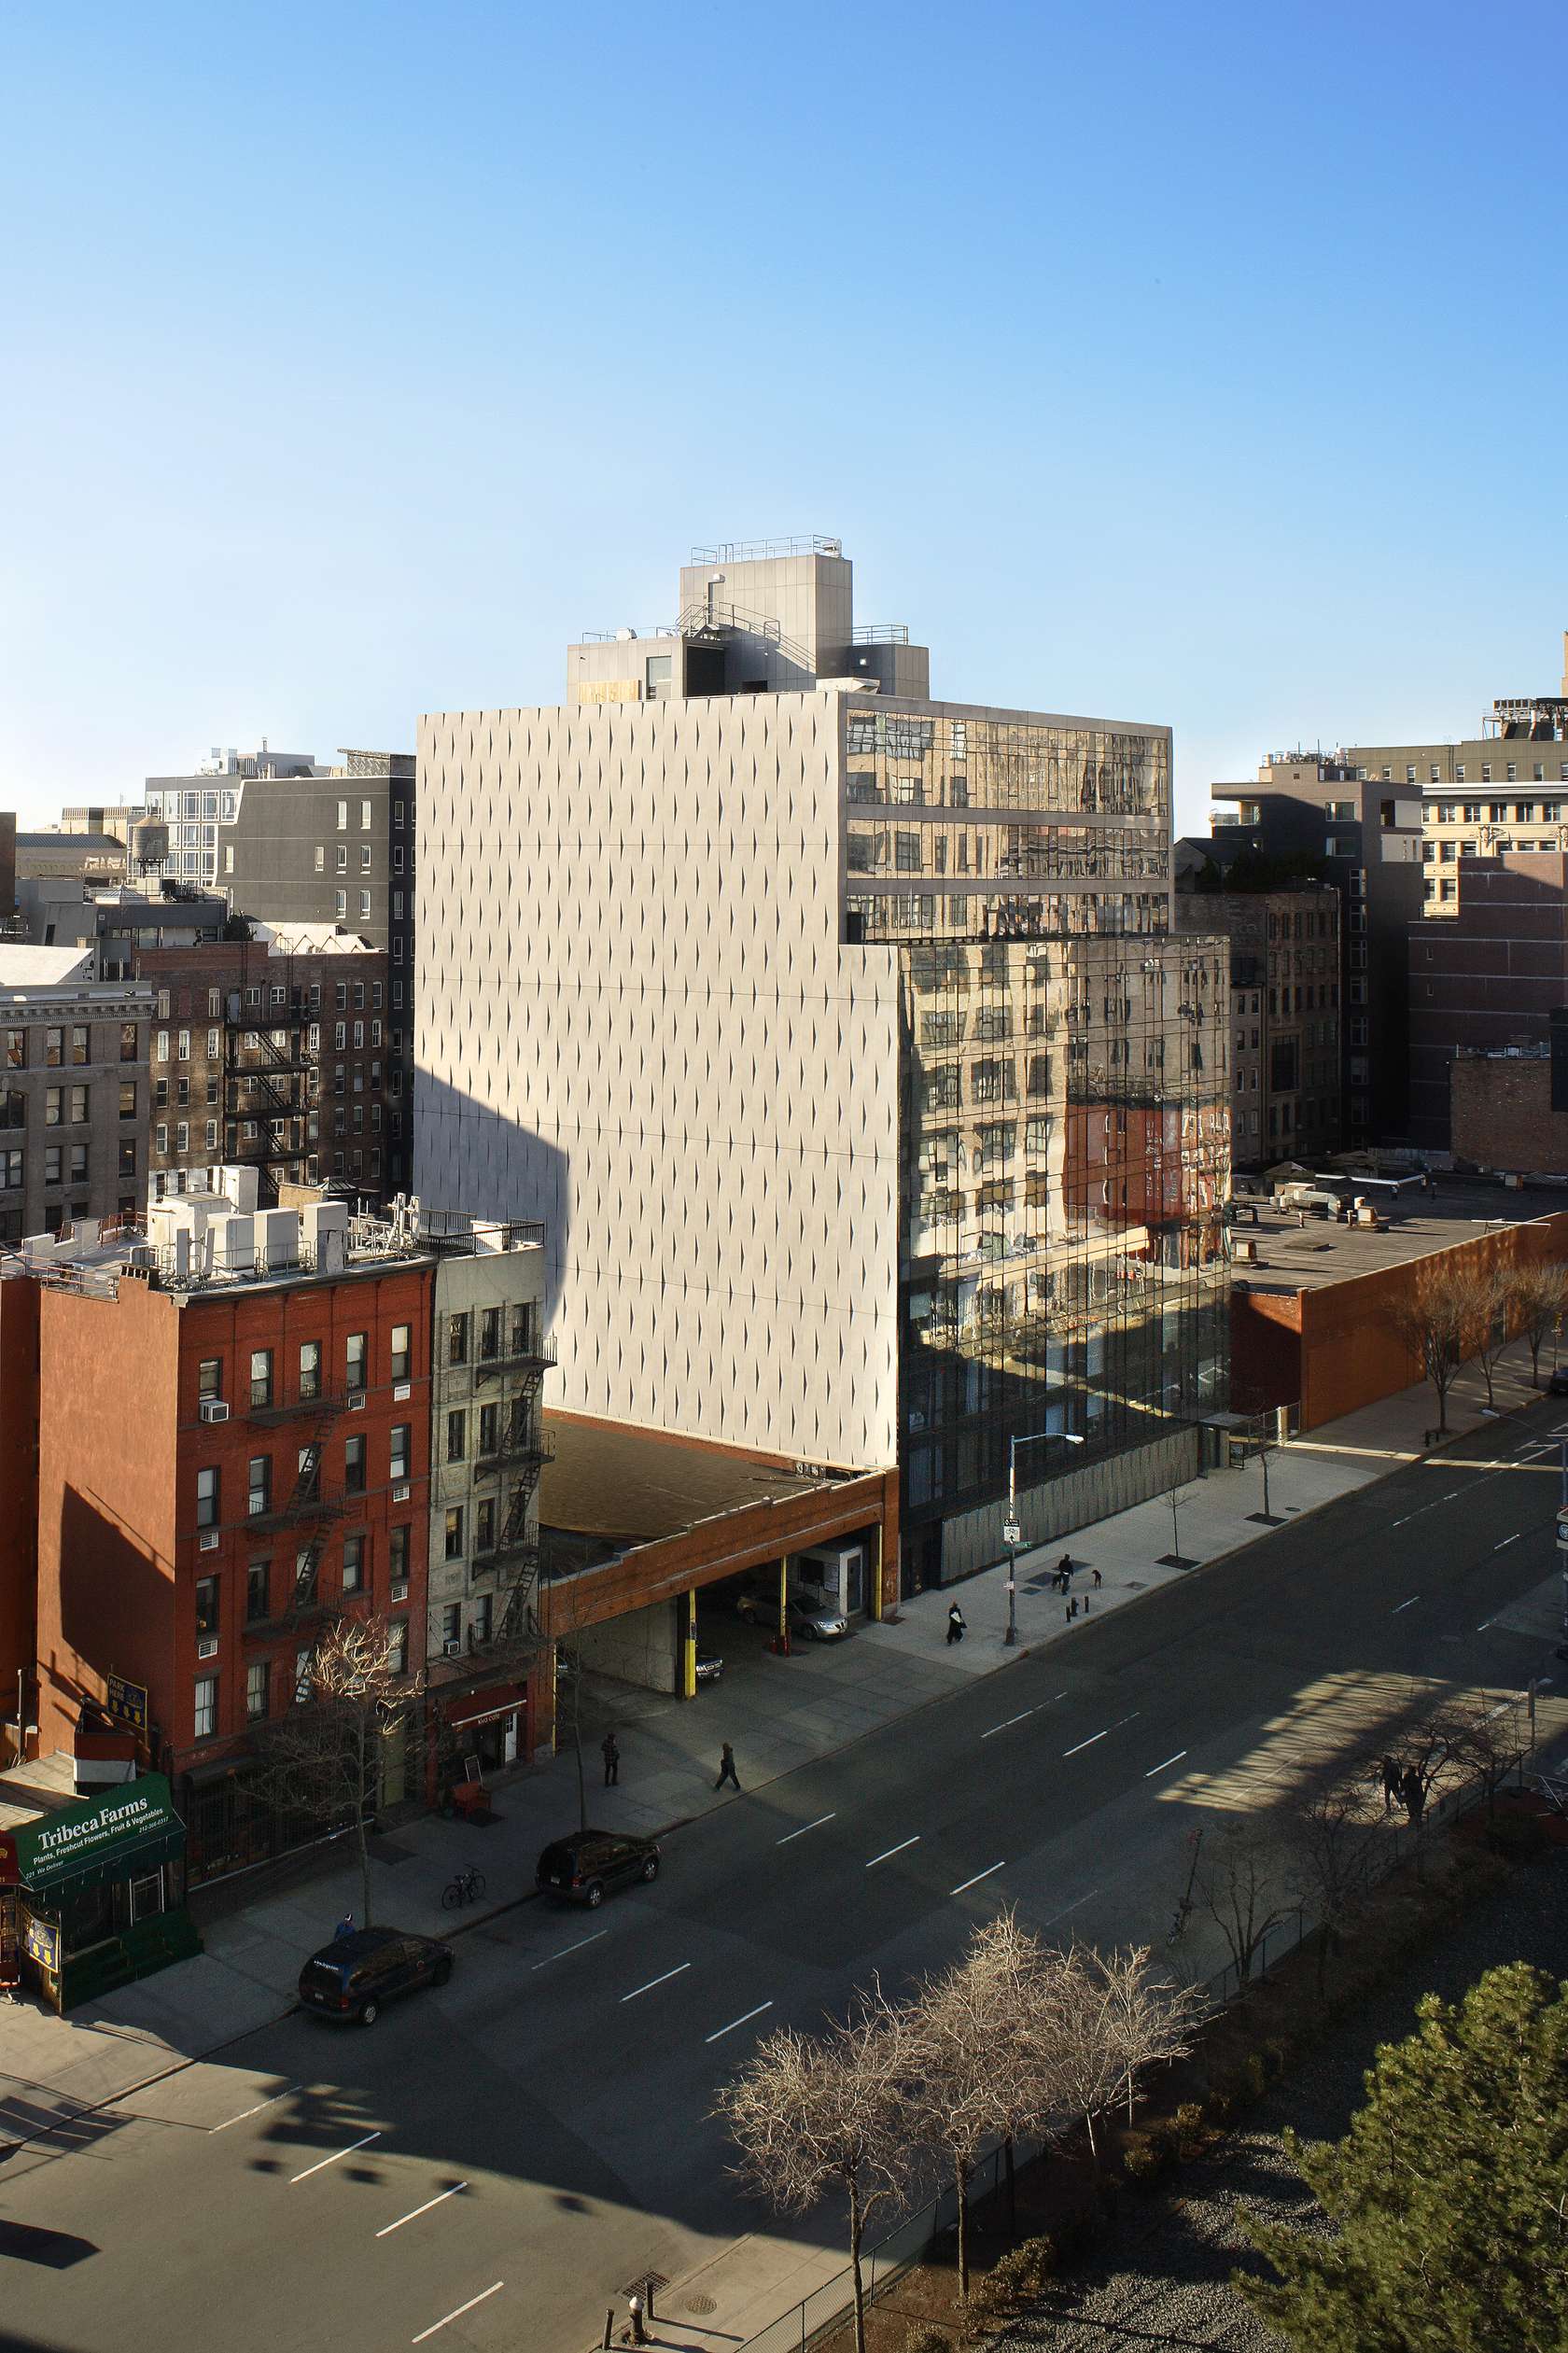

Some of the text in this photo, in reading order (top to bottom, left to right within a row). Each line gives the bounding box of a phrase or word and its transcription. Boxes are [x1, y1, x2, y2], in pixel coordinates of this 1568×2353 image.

[33, 1808, 163, 1865] Plants, Freshcut Flowers, Fruit & Vegetables
[37, 1798, 147, 1850] Tribeca Farms
[46, 1860, 64, 1872] Deliver
